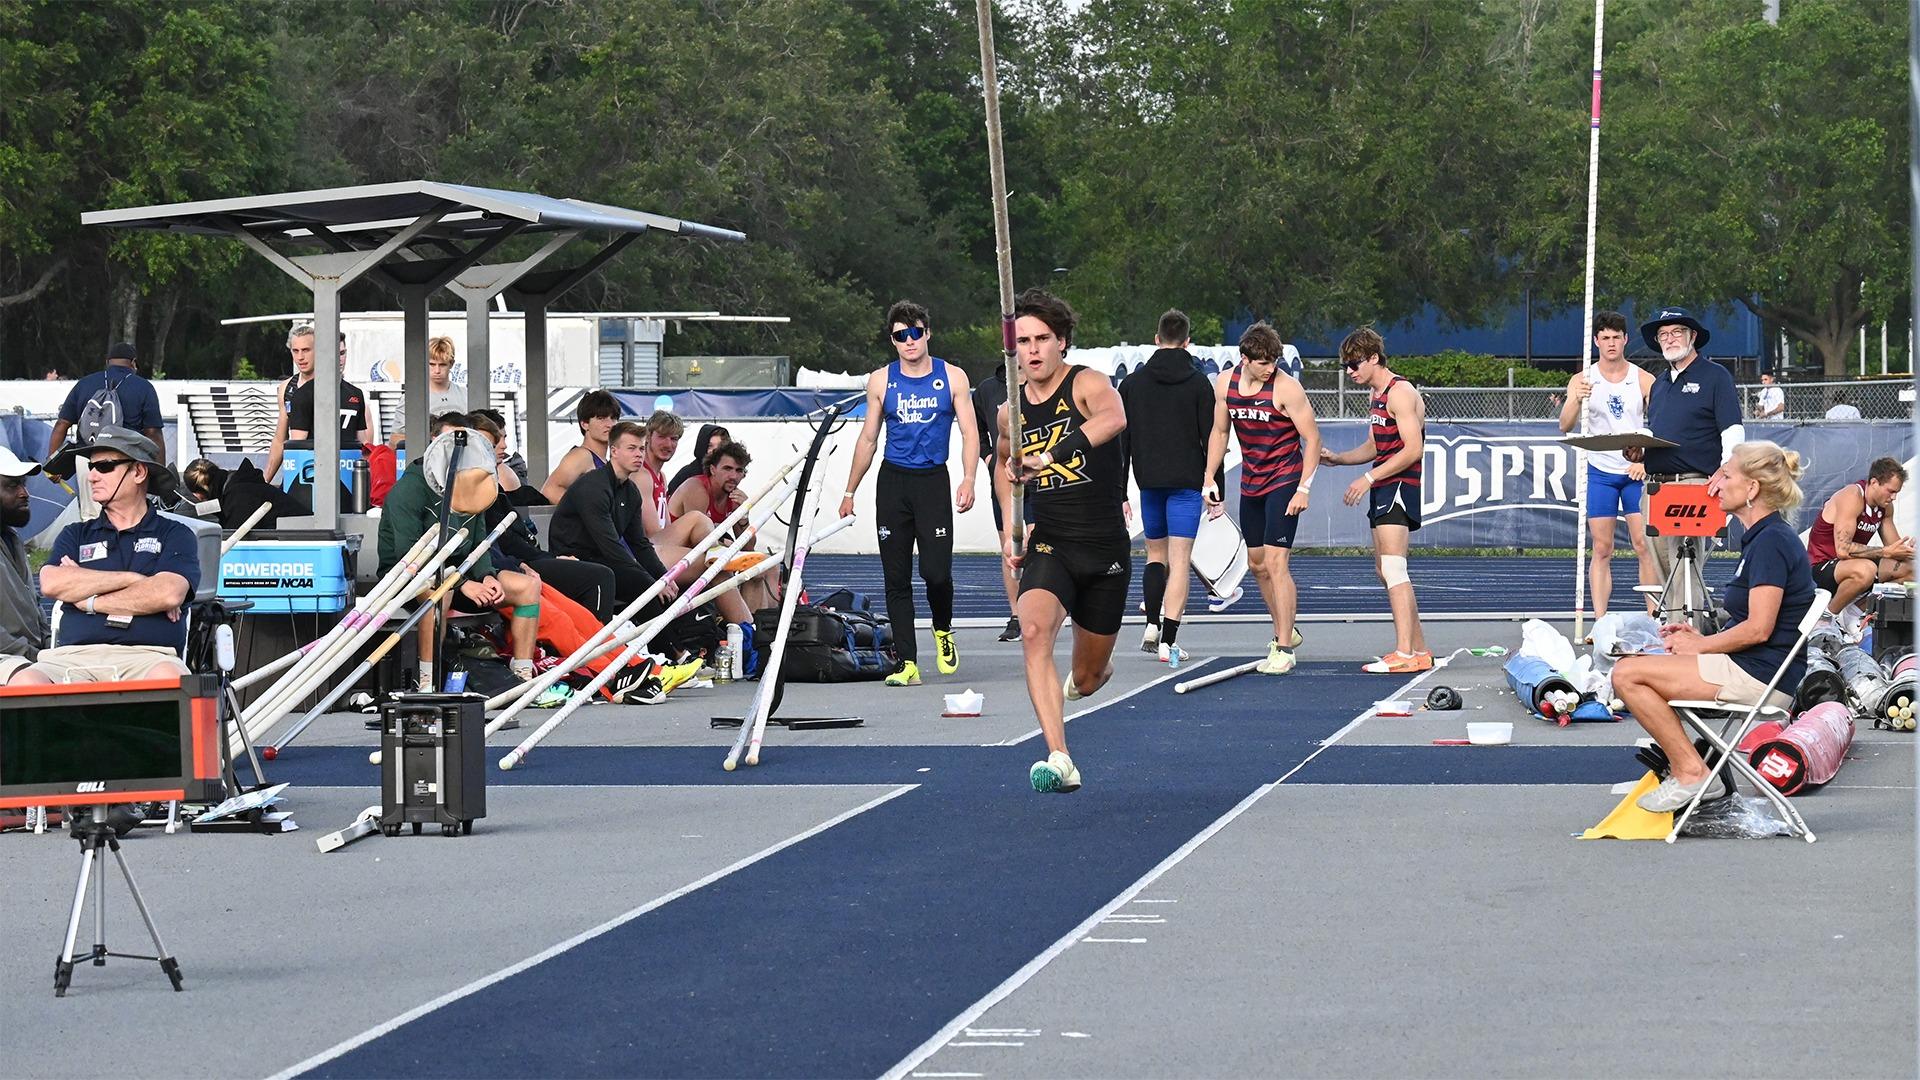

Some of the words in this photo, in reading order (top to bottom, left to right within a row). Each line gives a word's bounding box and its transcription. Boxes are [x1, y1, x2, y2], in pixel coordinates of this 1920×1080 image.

[896, 392, 938, 410] Indiana
[896, 409, 937, 424] State
[1229, 408, 1272, 422] PENN
[1420, 443, 1580, 517] OSPR
[1664, 504, 1708, 518] GILL
[223, 563, 314, 577] POWERADE
[281, 578, 314, 588] NCAA
[76, 781, 106, 793] GILL
